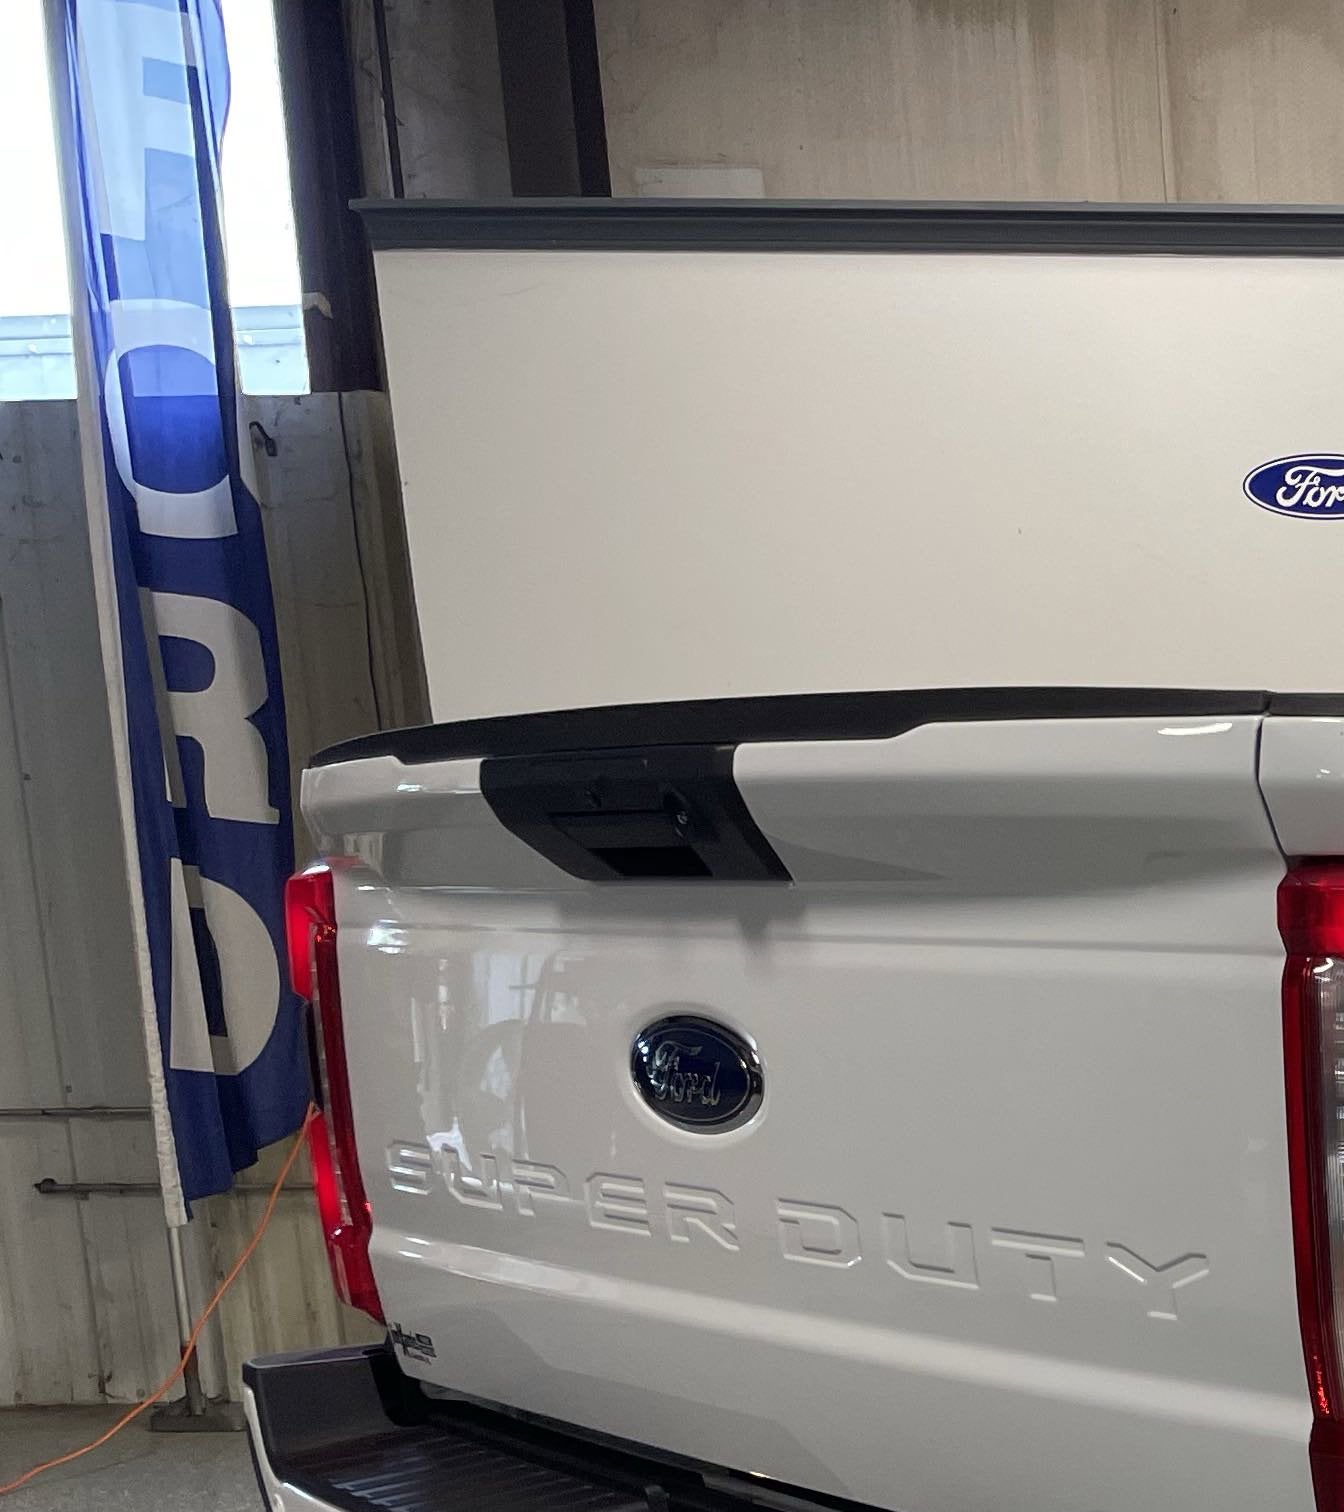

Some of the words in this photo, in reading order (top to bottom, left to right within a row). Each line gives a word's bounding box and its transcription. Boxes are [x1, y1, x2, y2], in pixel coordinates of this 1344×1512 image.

[75, 2, 280, 1076] FORD
[649, 1038, 722, 1110] Ford
[384, 1137, 741, 1253] SUPER
[776, 1196, 1211, 1322] DUTY
